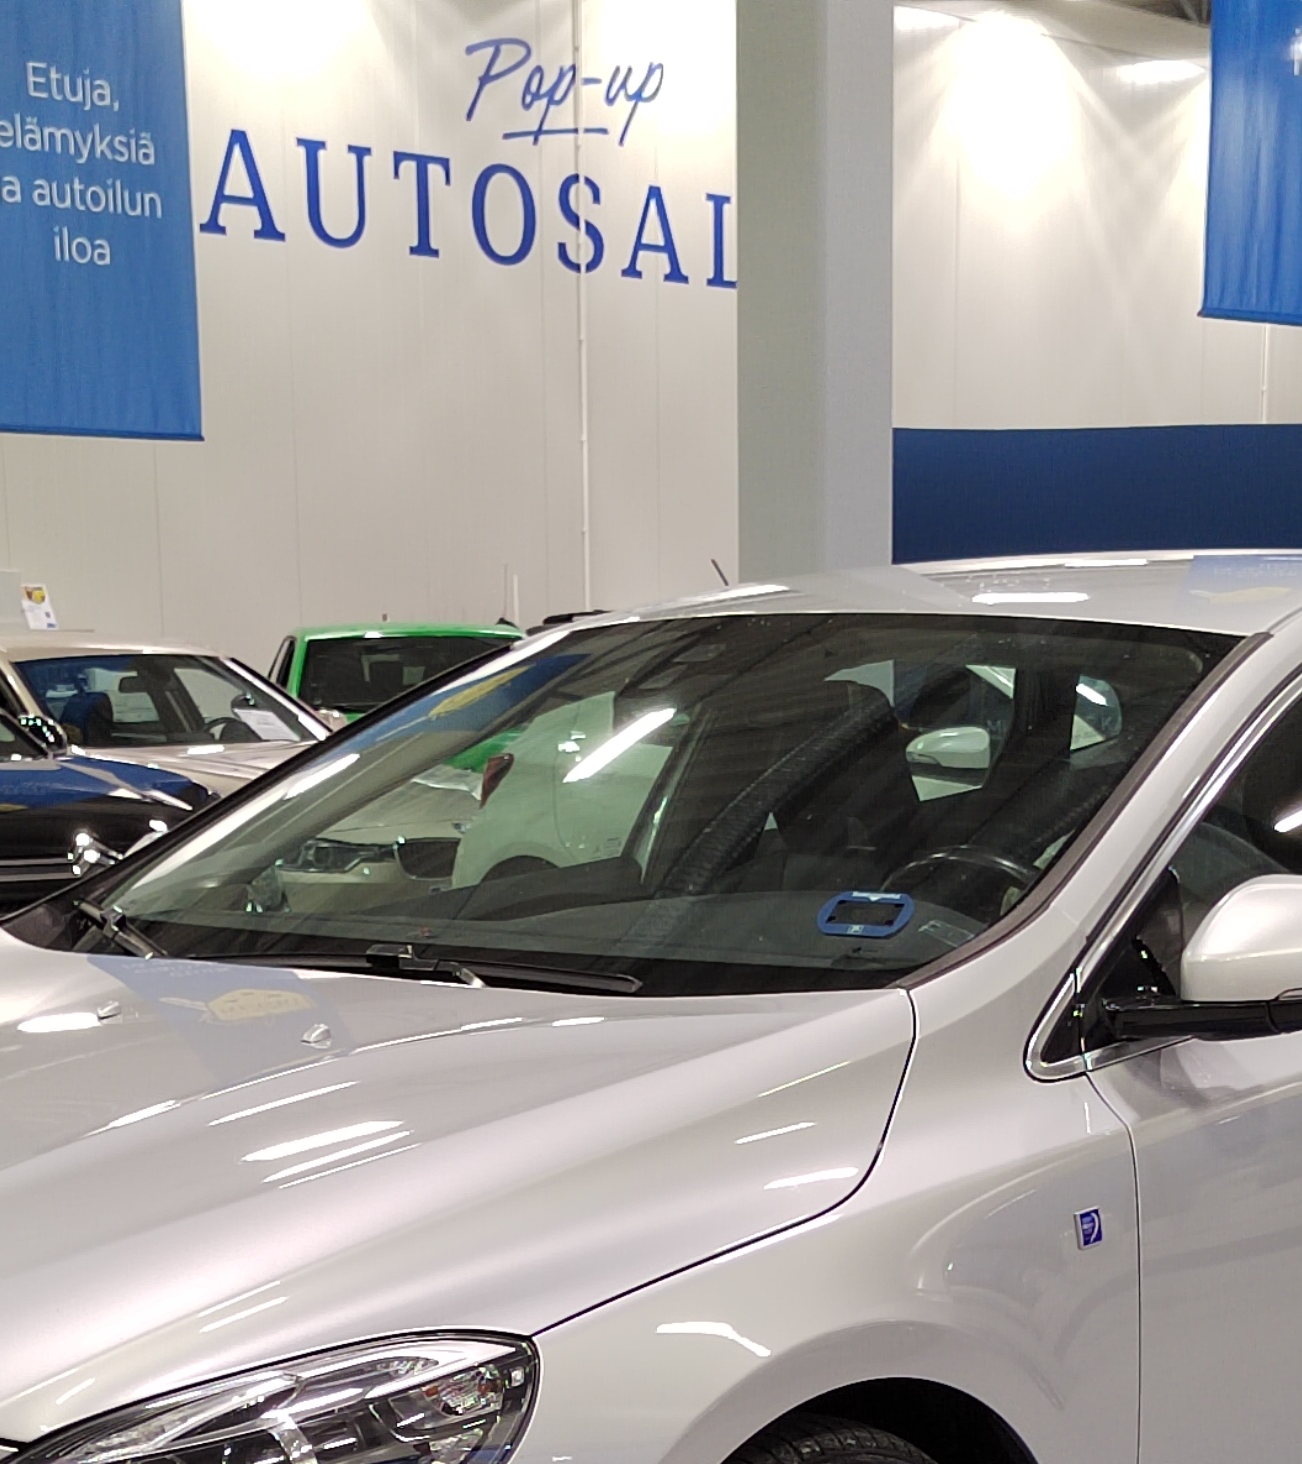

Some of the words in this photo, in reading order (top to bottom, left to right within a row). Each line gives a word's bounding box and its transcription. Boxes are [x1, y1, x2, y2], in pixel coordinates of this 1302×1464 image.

[26, 60, 120, 113] Etuja,
[465, 37, 664, 146] Pop-up
[32, 177, 162, 220] autoilun
[53, 226, 111, 266] iloa
